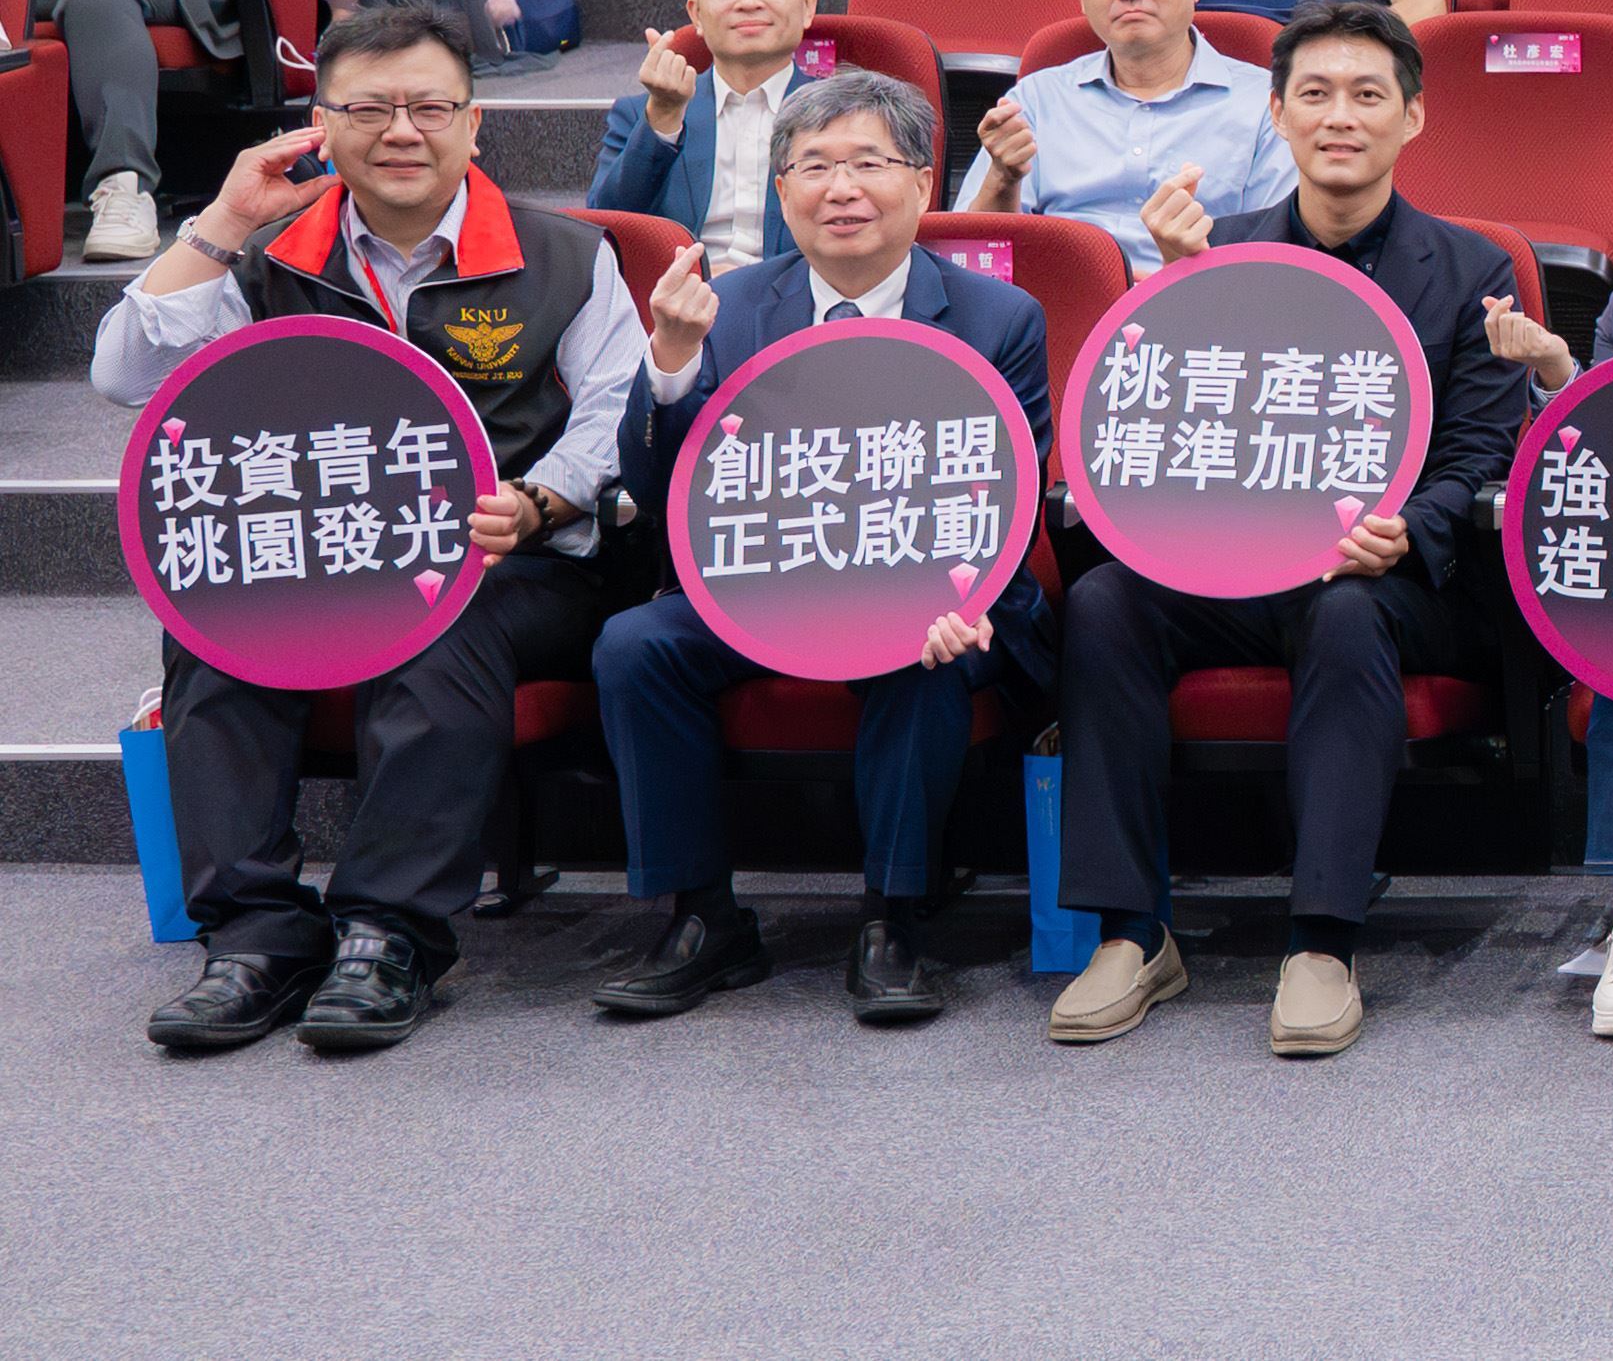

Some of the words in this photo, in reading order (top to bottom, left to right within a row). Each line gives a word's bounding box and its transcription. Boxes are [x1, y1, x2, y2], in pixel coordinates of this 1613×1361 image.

[460, 307, 508, 323] KNU
[1098, 340, 1400, 421] 桃青產業
[151, 417, 458, 512] 投資青年
[705, 413, 1002, 503] 創投聯盟
[1089, 415, 1392, 494] 精準加速
[158, 494, 465, 591] 桃園發光
[702, 489, 1001, 578] 正式啟動
